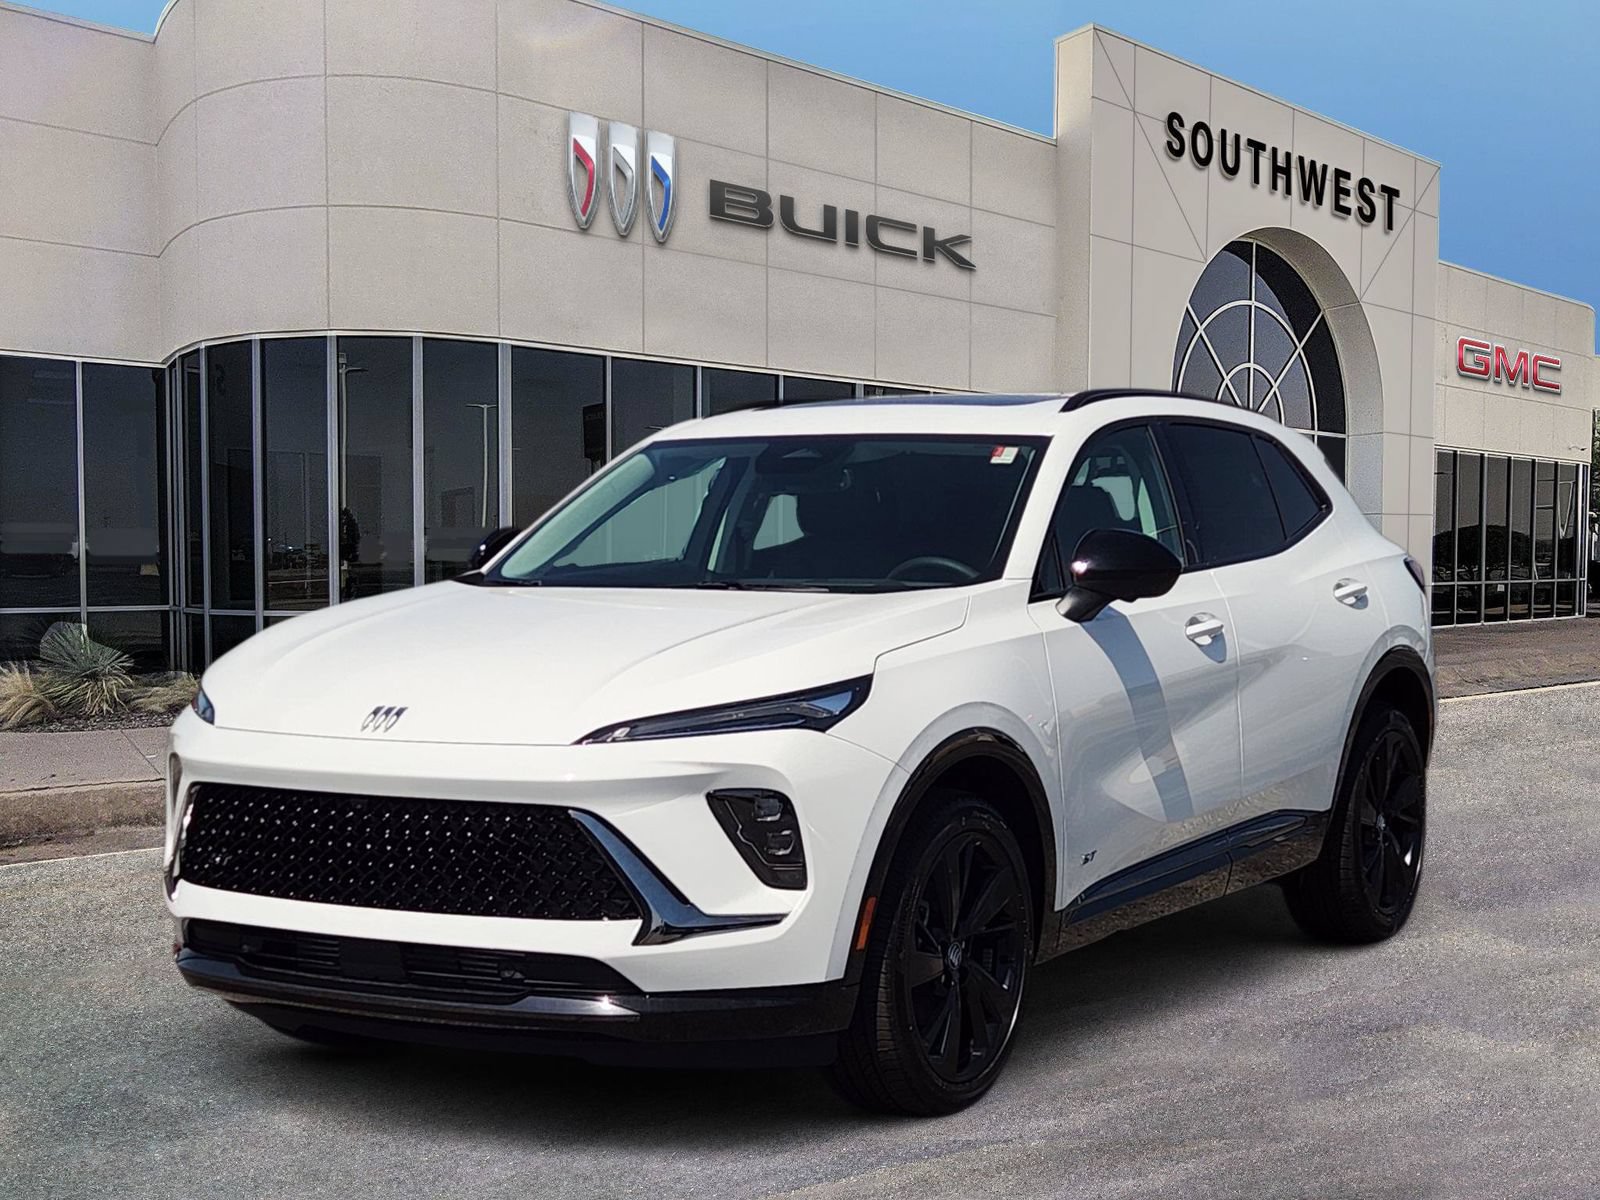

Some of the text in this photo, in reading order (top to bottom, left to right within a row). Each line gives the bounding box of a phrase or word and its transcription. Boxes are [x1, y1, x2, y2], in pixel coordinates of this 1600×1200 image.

[1166, 111, 1400, 231] SOUTHWEST
[709, 179, 976, 270] BUICK
[1457, 336, 1561, 394] GMC
